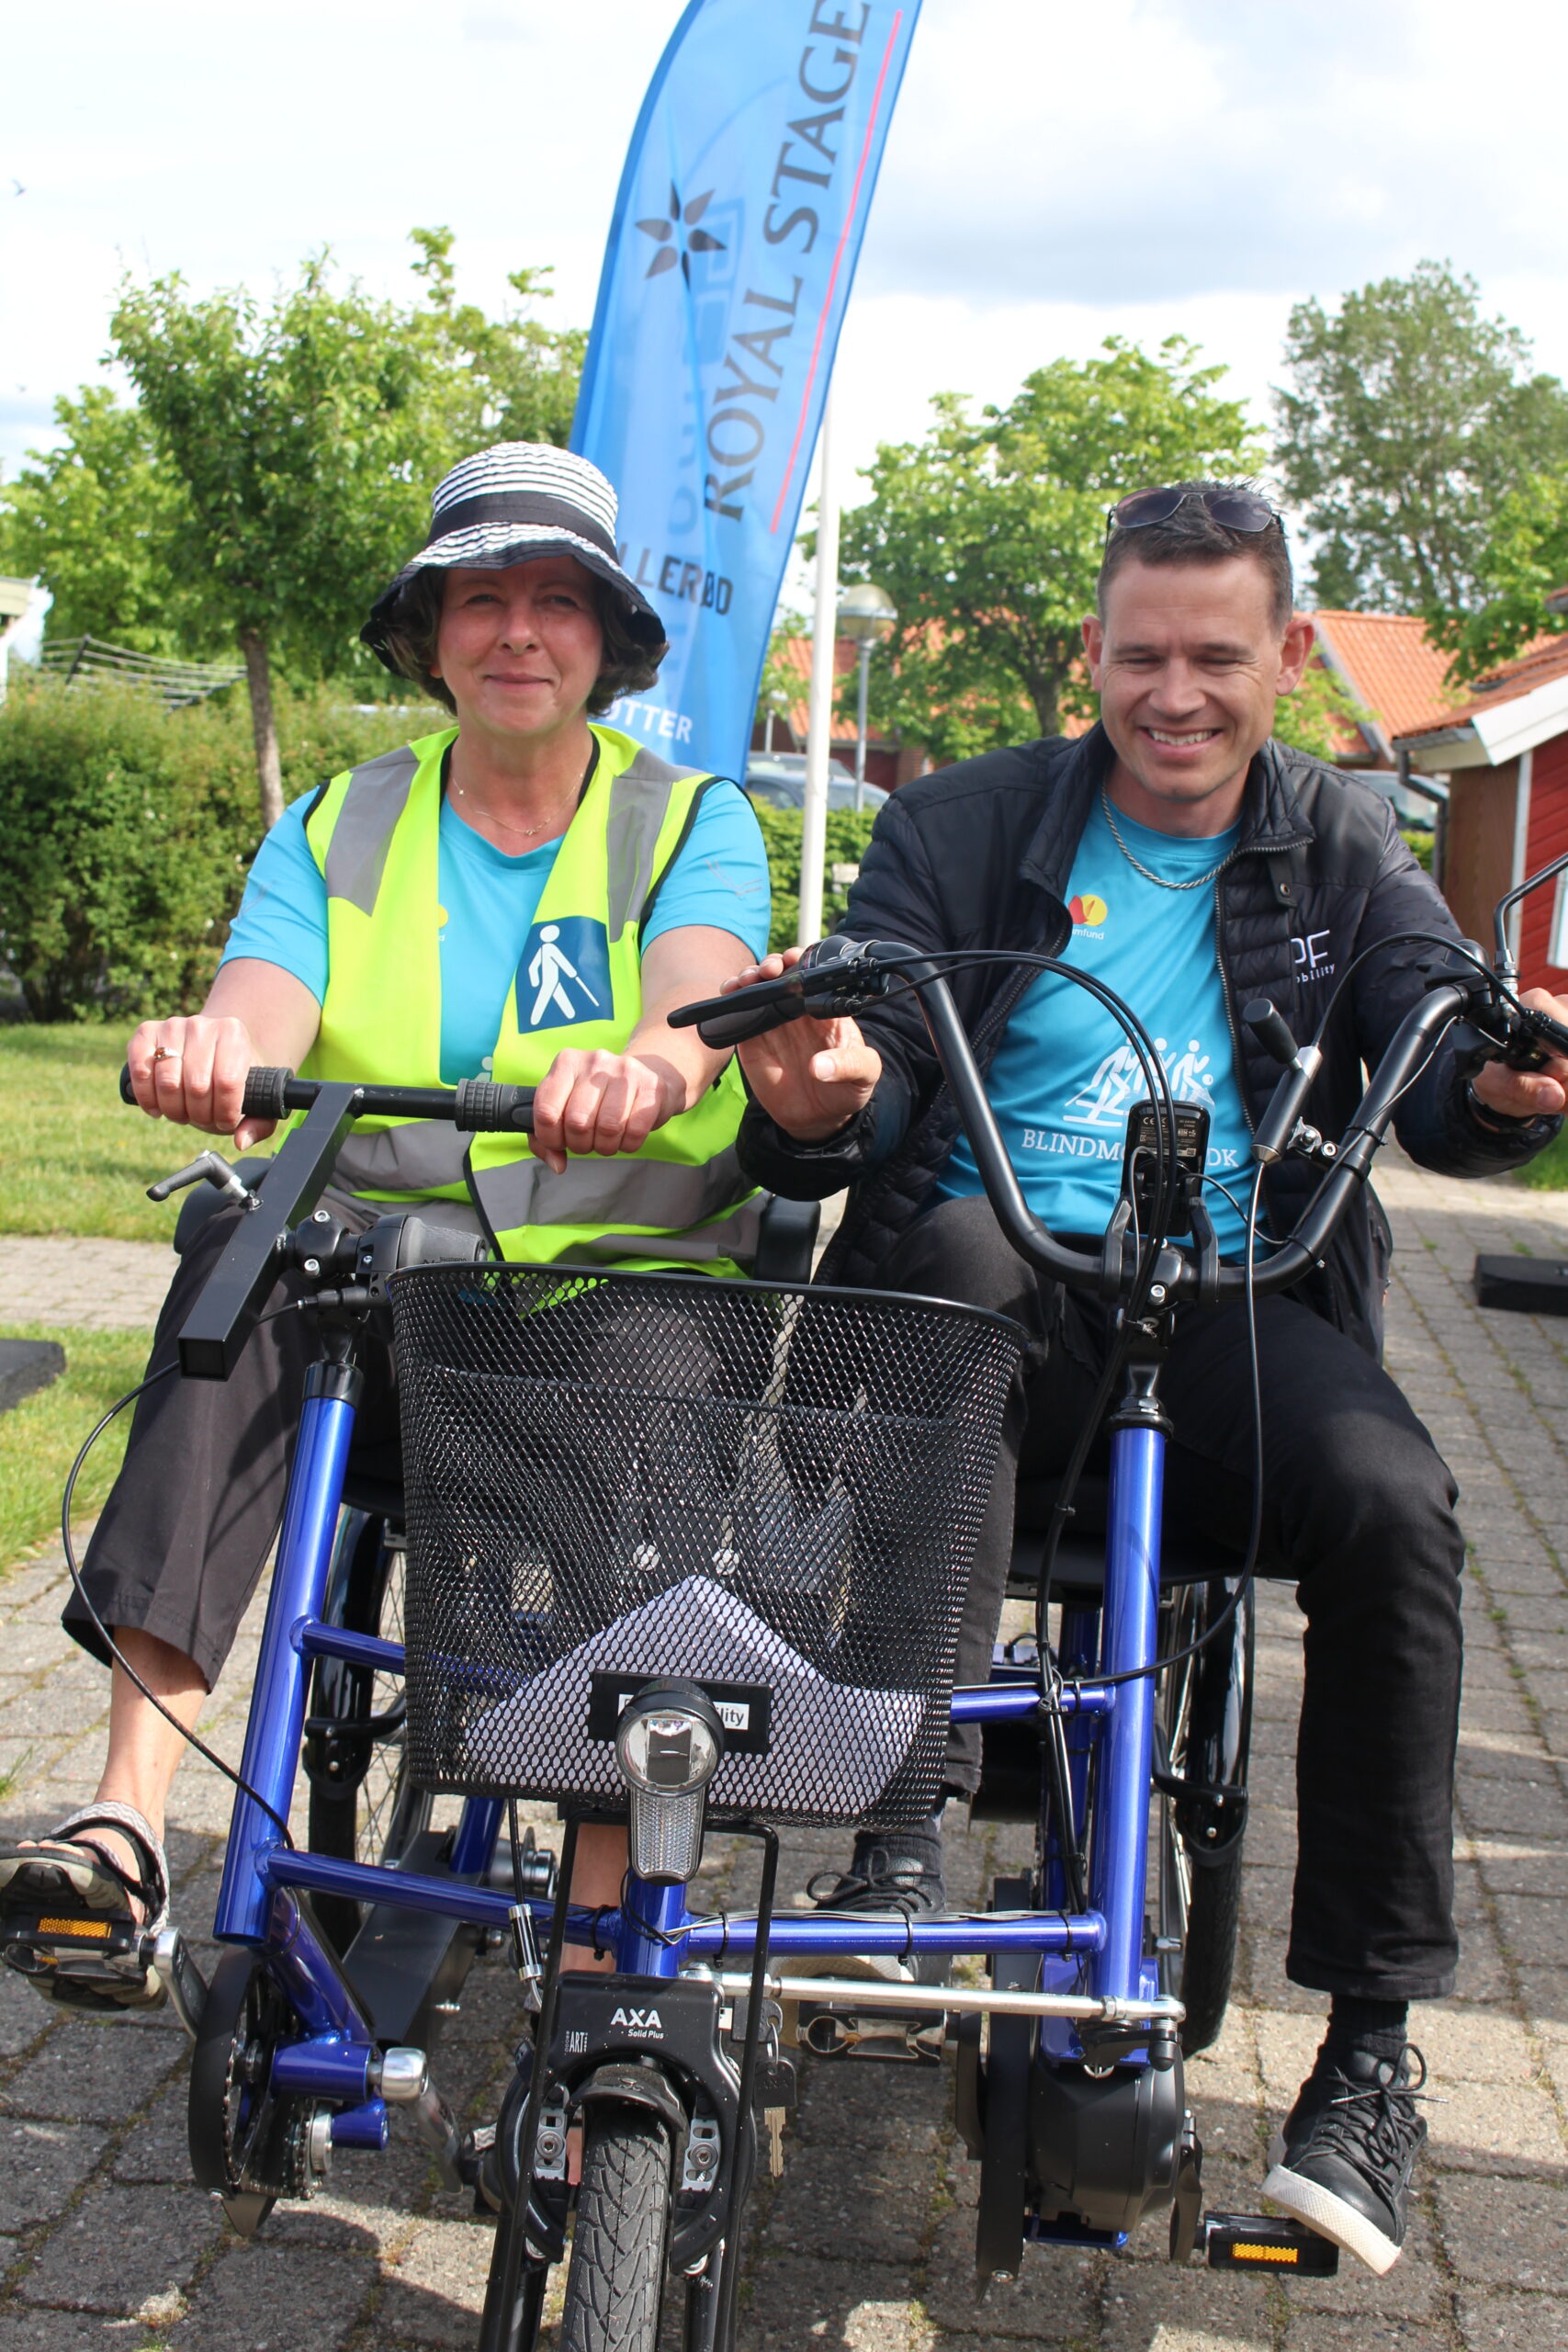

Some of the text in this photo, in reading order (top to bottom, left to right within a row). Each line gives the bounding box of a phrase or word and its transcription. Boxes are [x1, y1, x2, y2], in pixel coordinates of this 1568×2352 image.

[705, 0, 871, 523] ROYAL STAGE
[618, 542, 733, 616] LERØD
[1021, 1128, 1125, 1162] BLINDM
[716, 1706, 745, 1726] lity
[610, 2007, 662, 2029] AXA
[569, 2030, 585, 2053] ART
[627, 2029, 664, 2040] Solid Plus
